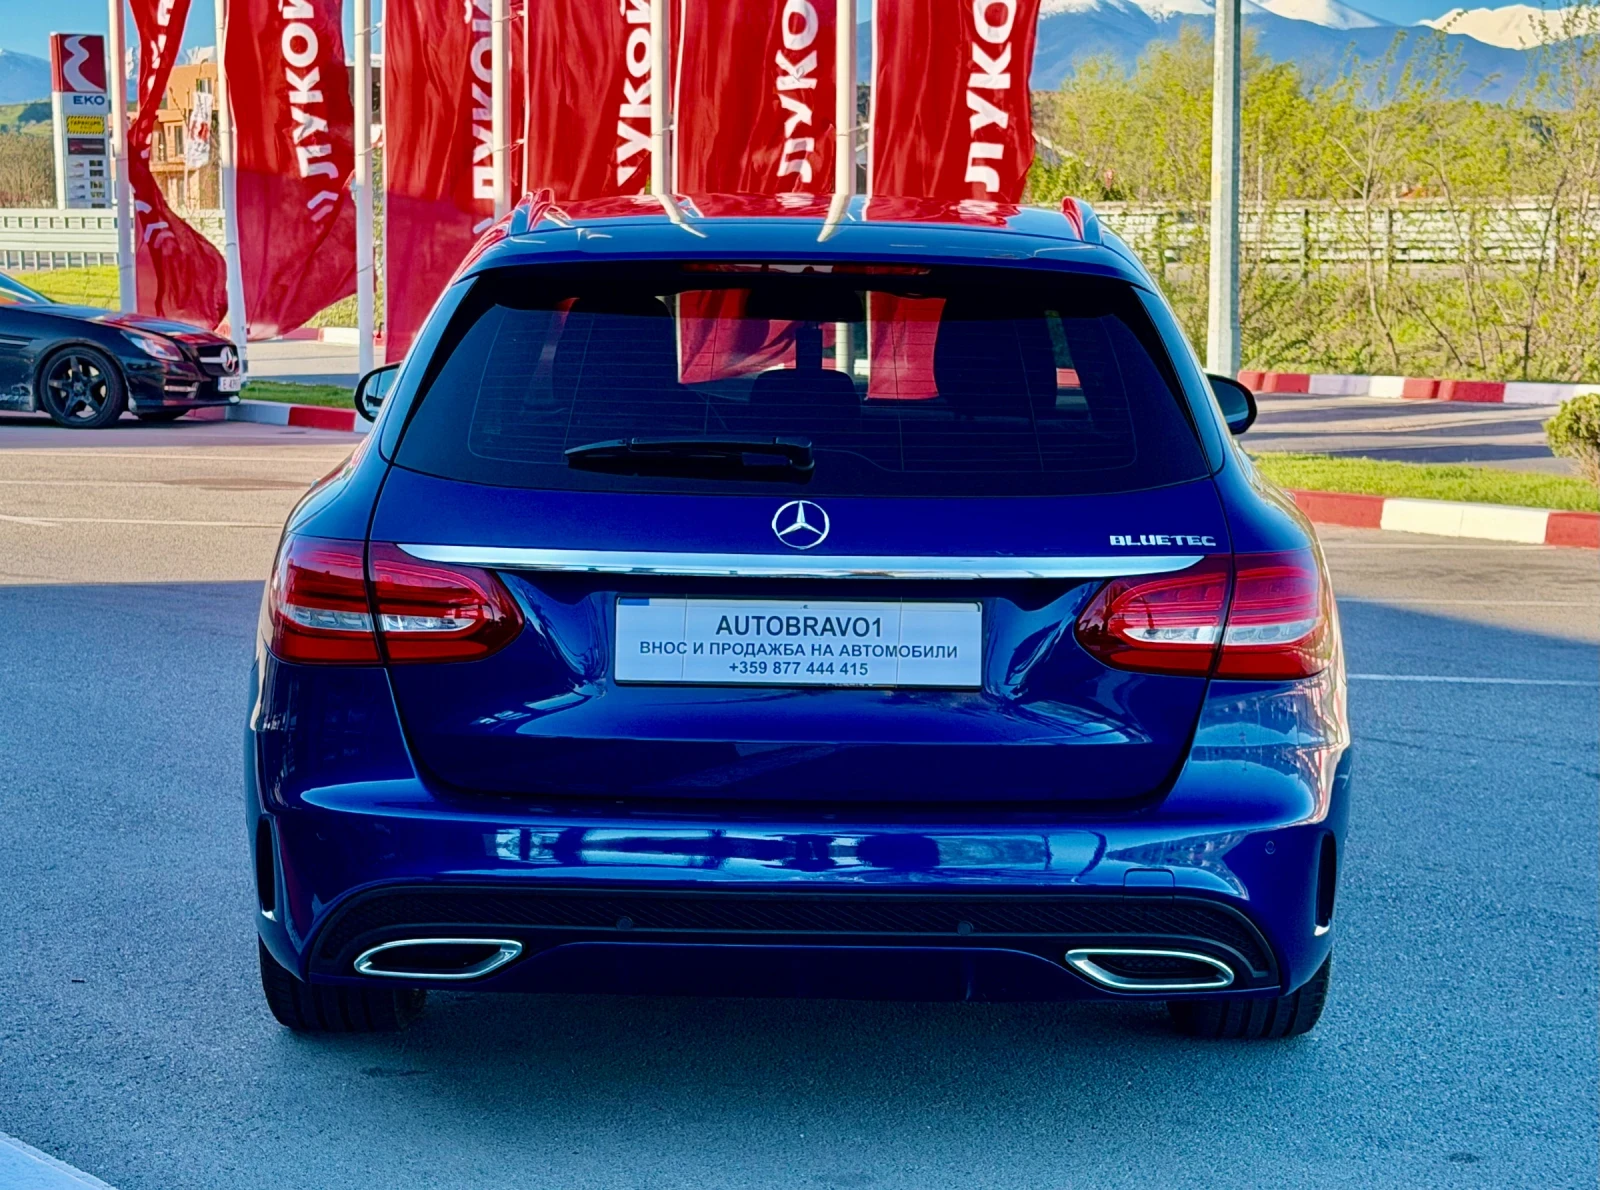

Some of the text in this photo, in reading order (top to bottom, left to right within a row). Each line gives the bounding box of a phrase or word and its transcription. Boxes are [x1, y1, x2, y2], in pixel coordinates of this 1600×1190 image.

[73, 95, 105, 106] EKO
[1109, 534, 1217, 547] BLUETEC
[715, 615, 882, 638] AUTOBRAVO1
[639, 641, 958, 659] ВНОС И ПРОДАЖБА НА АВТОМОБИЛИ
[729, 661, 869, 676] +359 877 444 415
